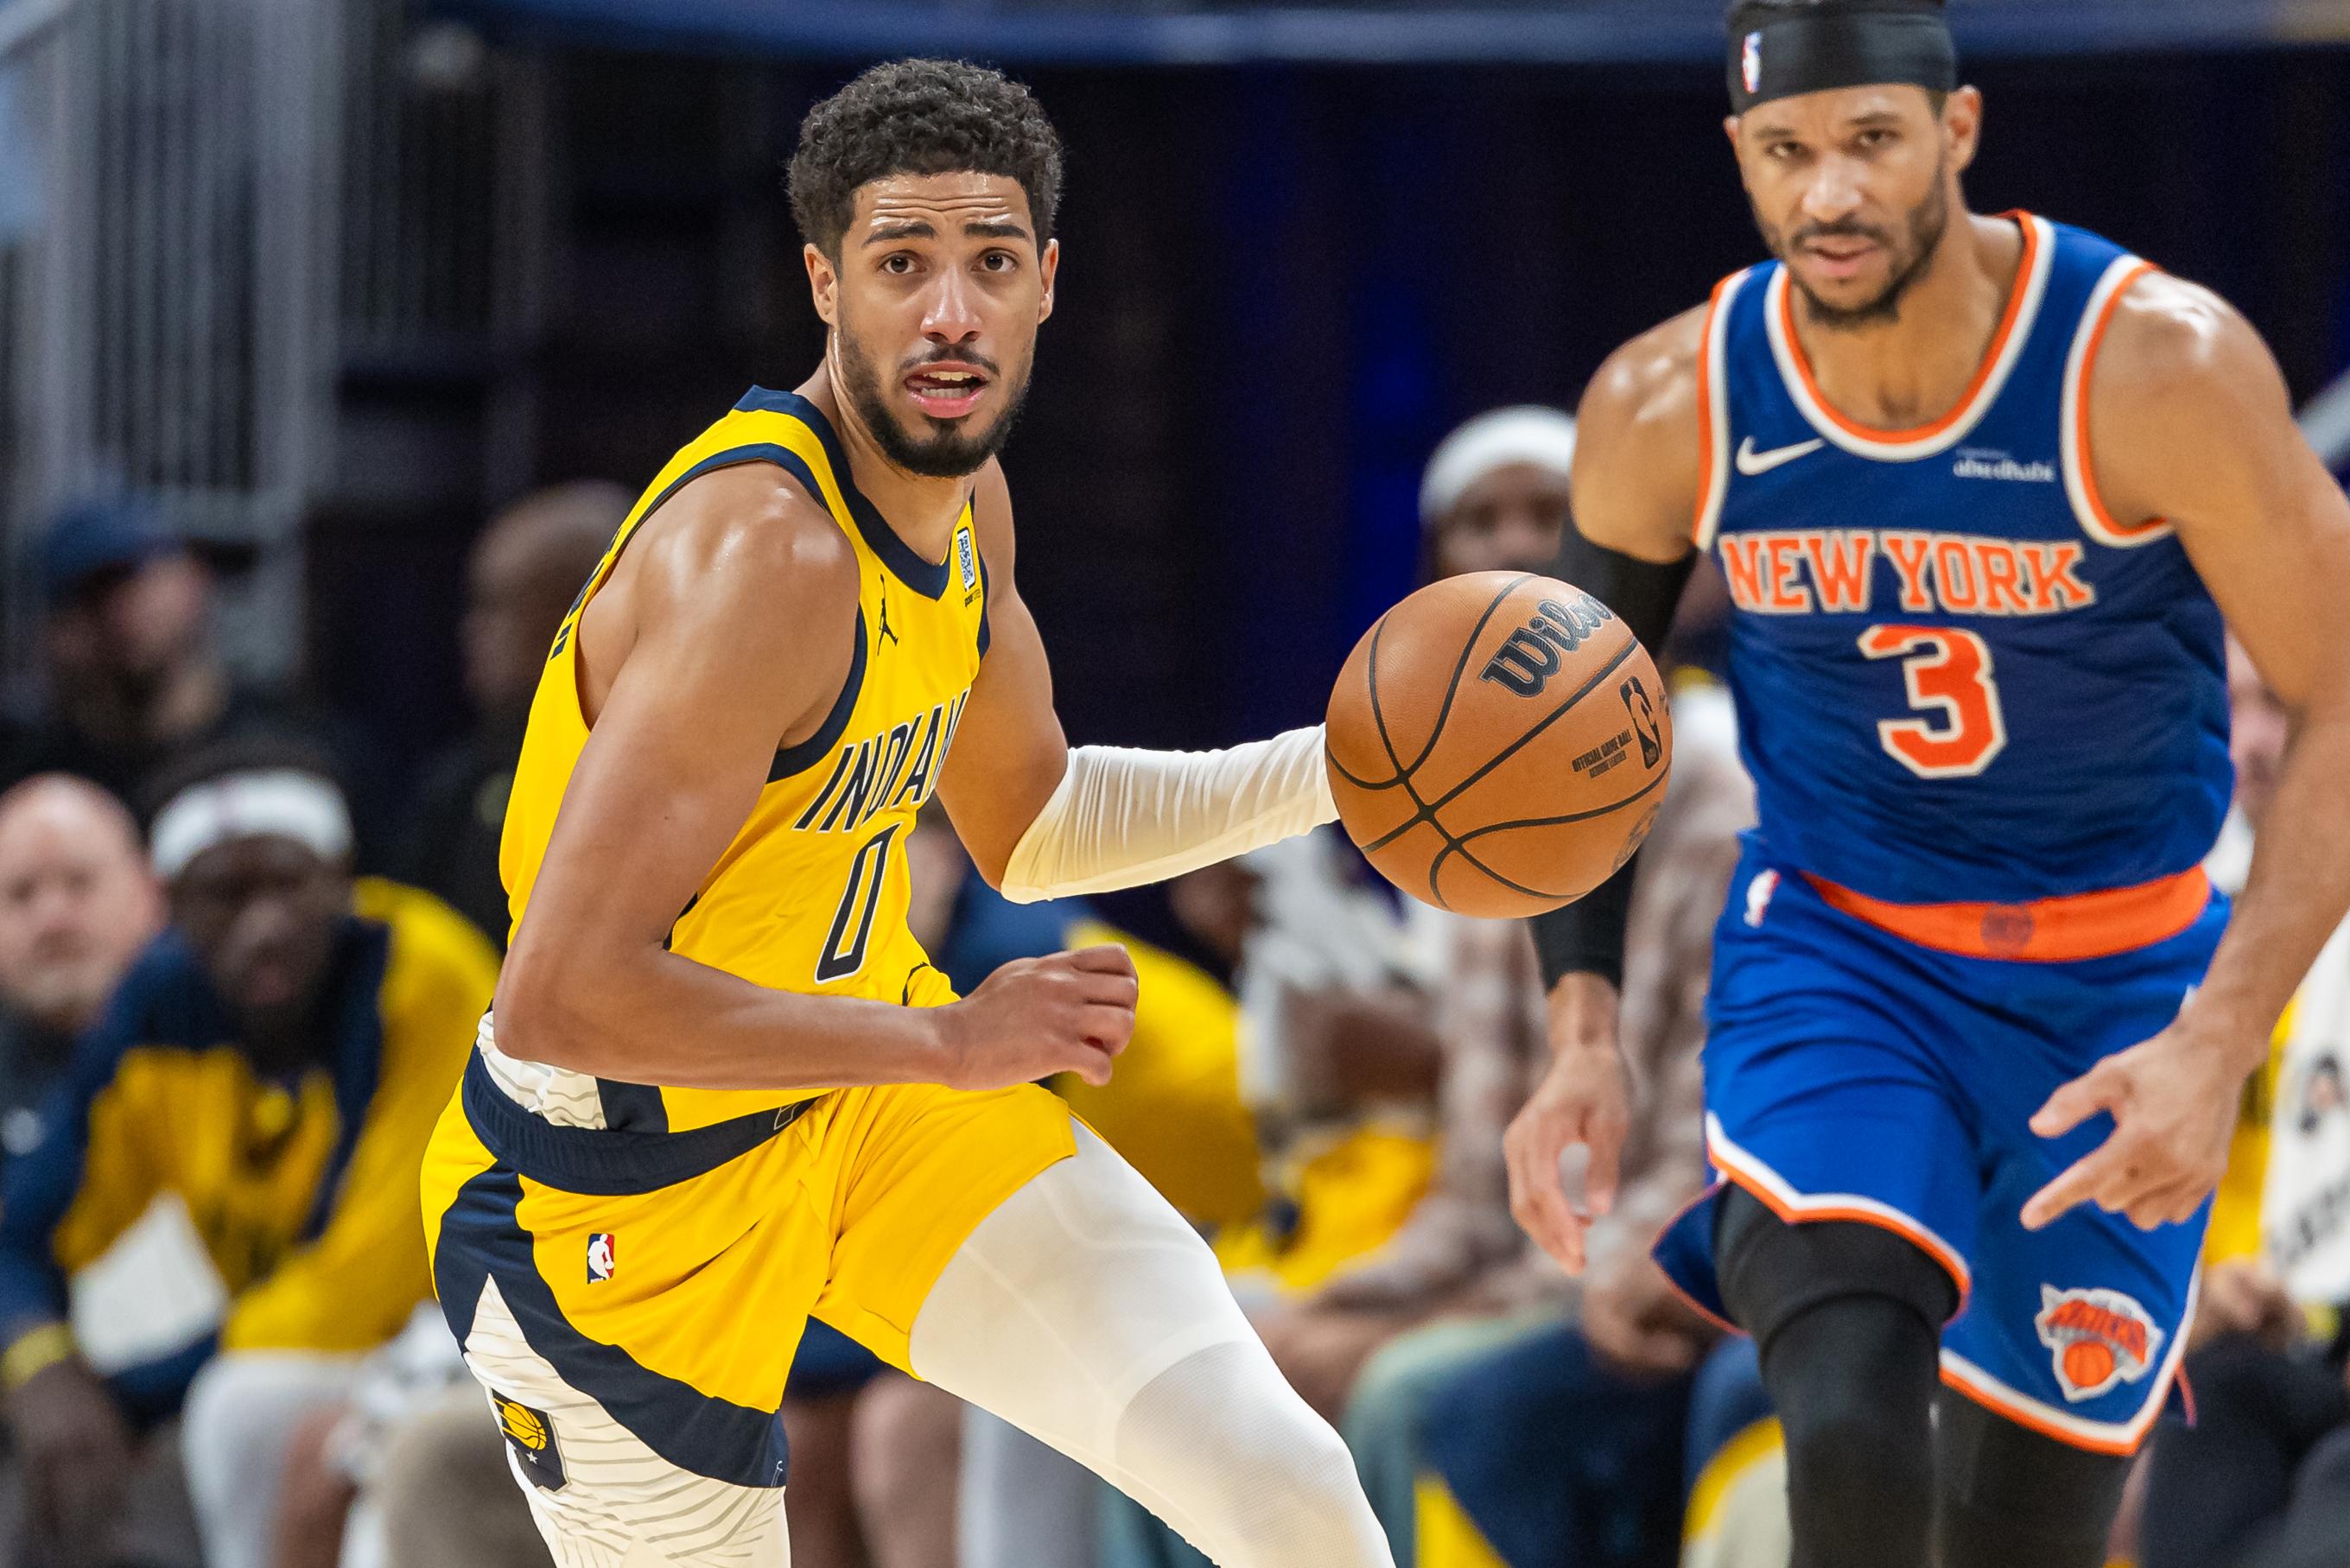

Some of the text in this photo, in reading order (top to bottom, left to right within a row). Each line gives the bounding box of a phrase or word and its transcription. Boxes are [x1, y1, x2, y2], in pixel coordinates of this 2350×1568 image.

[1718, 529, 2096, 616] NEW YORK
[791, 688, 971, 834] INDIAN
[1858, 625, 2007, 779] 3
[815, 822, 904, 986] 0
